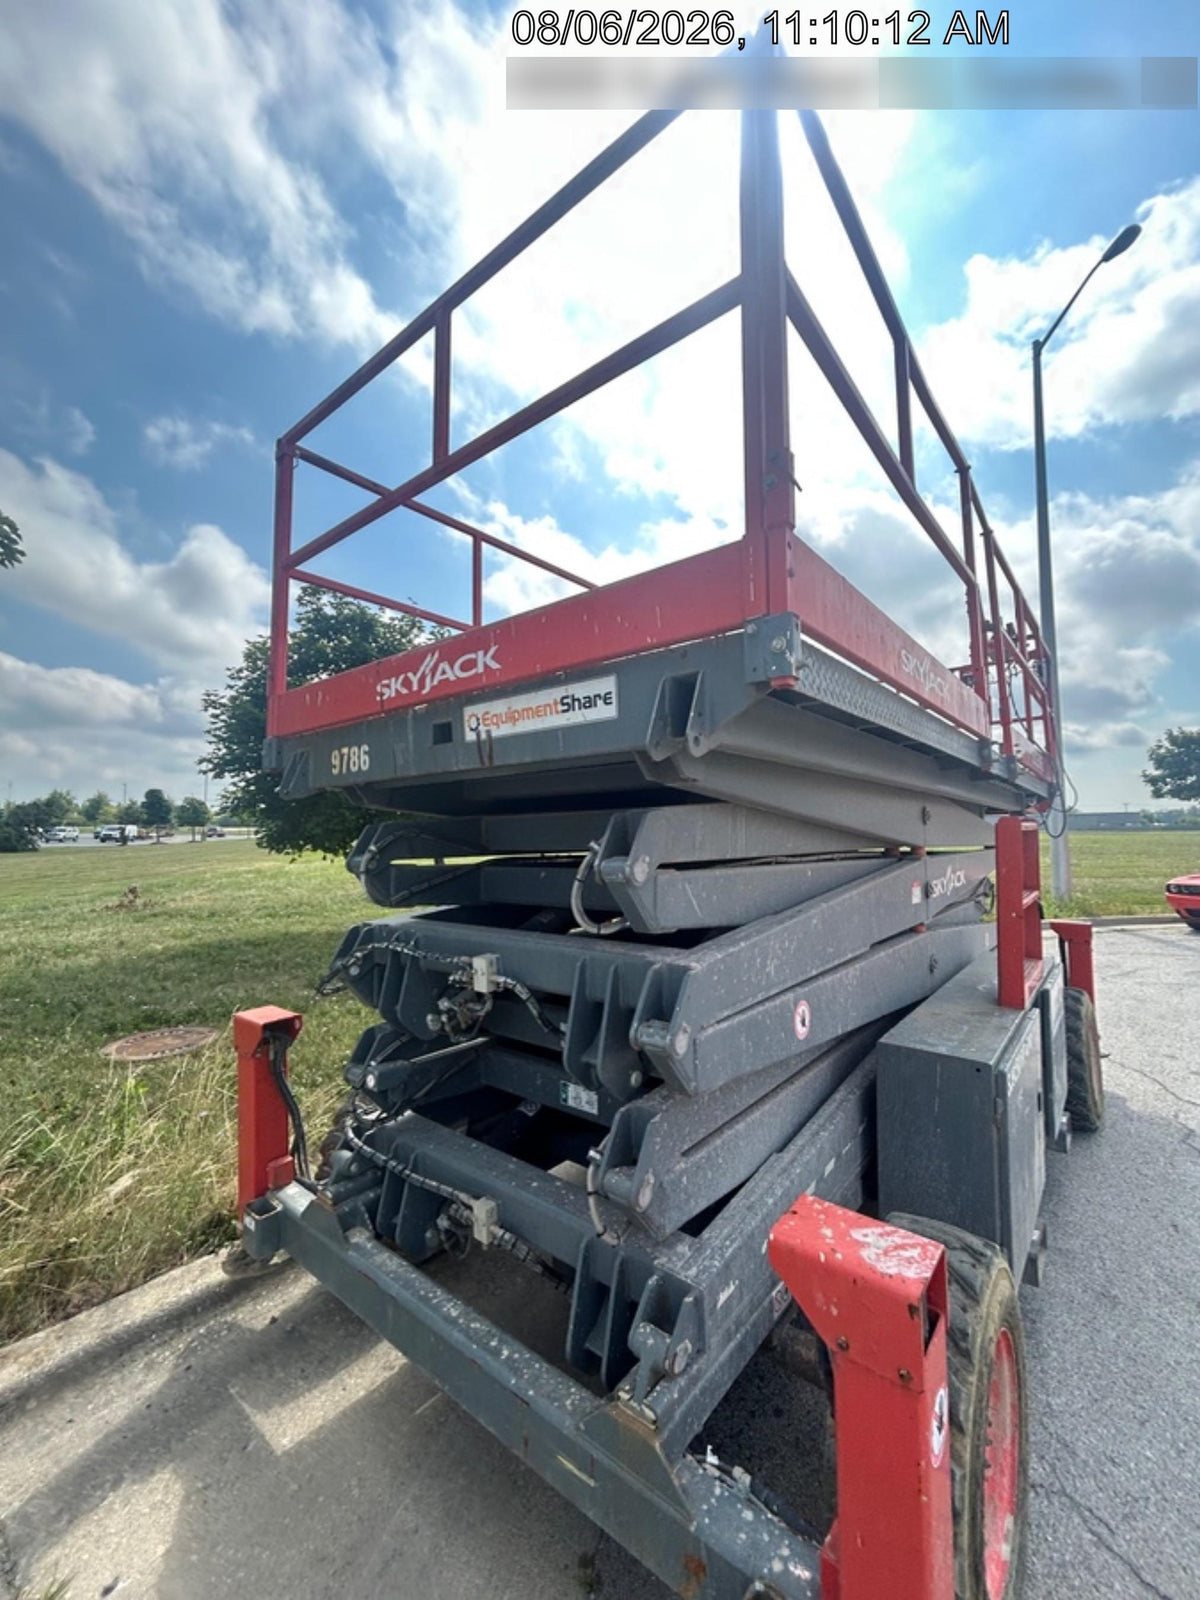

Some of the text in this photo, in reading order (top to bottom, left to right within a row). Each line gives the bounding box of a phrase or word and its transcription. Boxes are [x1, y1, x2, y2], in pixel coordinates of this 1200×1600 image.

[376, 645, 501, 701] SKYJACK
[481, 690, 613, 728] EquipmentShare
[331, 744, 370, 775] 9786
